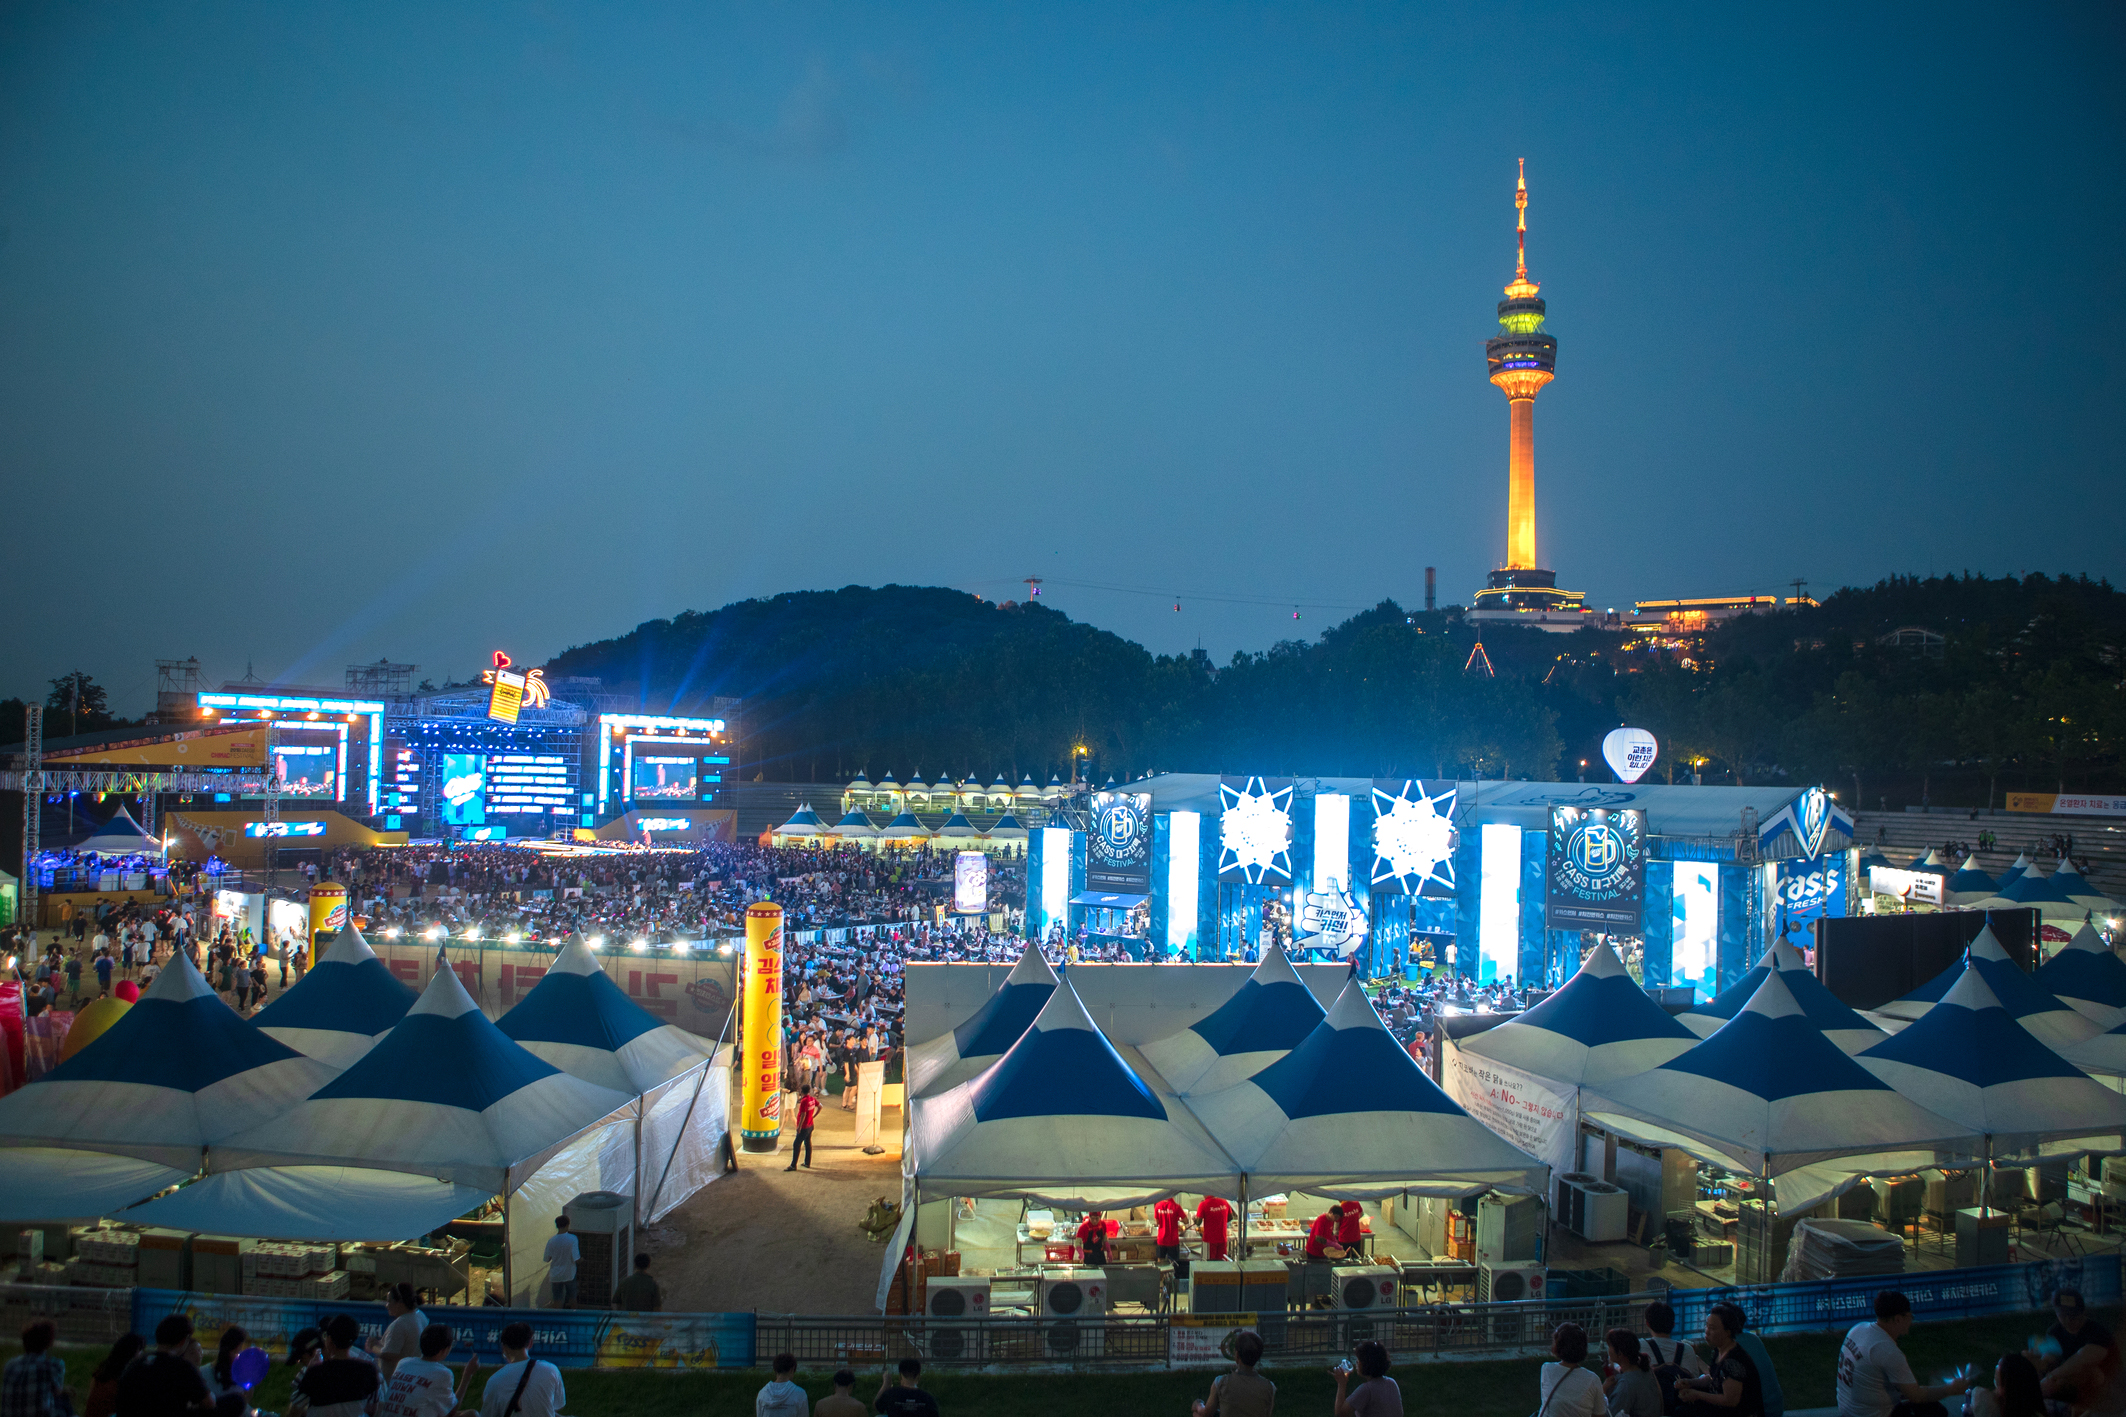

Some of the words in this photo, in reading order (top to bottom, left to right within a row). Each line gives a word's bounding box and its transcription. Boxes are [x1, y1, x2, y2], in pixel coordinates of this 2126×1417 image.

[1633, 746, 1652, 754] 교촌은
[1628, 754, 1641, 762] 이런
[2089, 799, 2109, 809] 치료는
[1097, 835, 1115, 858] CASS
[1103, 856, 1136, 868] FESTIVAL
[1562, 860, 1589, 888] CASS
[1591, 863, 1629, 890] 대구치맥
[1572, 886, 1621, 901] FESTIVAL
[1316, 909, 1347, 920] 카스먼저
[1320, 919, 1348, 933] 카먼!
[761, 1049, 781, 1069] 일
[761, 1072, 781, 1092] 일
[1478, 1069, 1491, 1082] 작은
[391, 1381, 417, 1394] DOWN
[389, 1392, 407, 1403] AND
